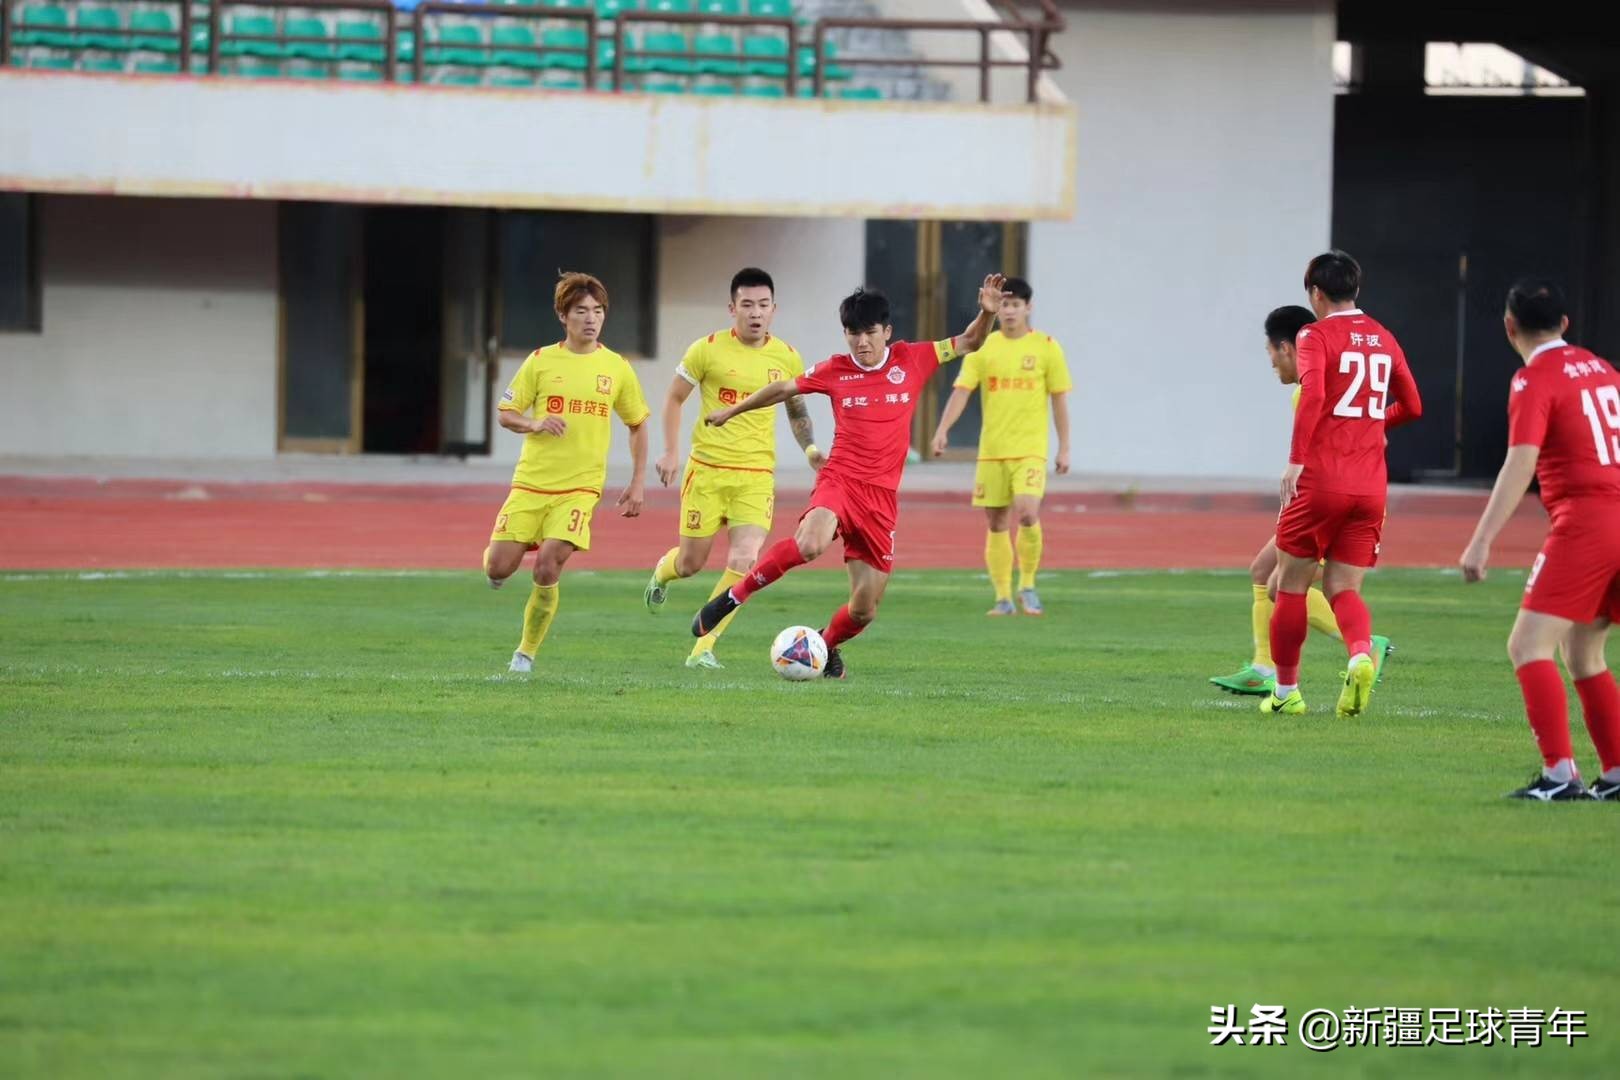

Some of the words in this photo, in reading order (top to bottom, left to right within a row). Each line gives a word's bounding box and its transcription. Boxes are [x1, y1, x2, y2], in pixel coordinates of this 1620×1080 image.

[839, 373, 864, 381] KELME
[1333, 351, 1392, 420] 29
[568, 399, 609, 417] 借贷宝
[1581, 384, 1620, 466] 19
